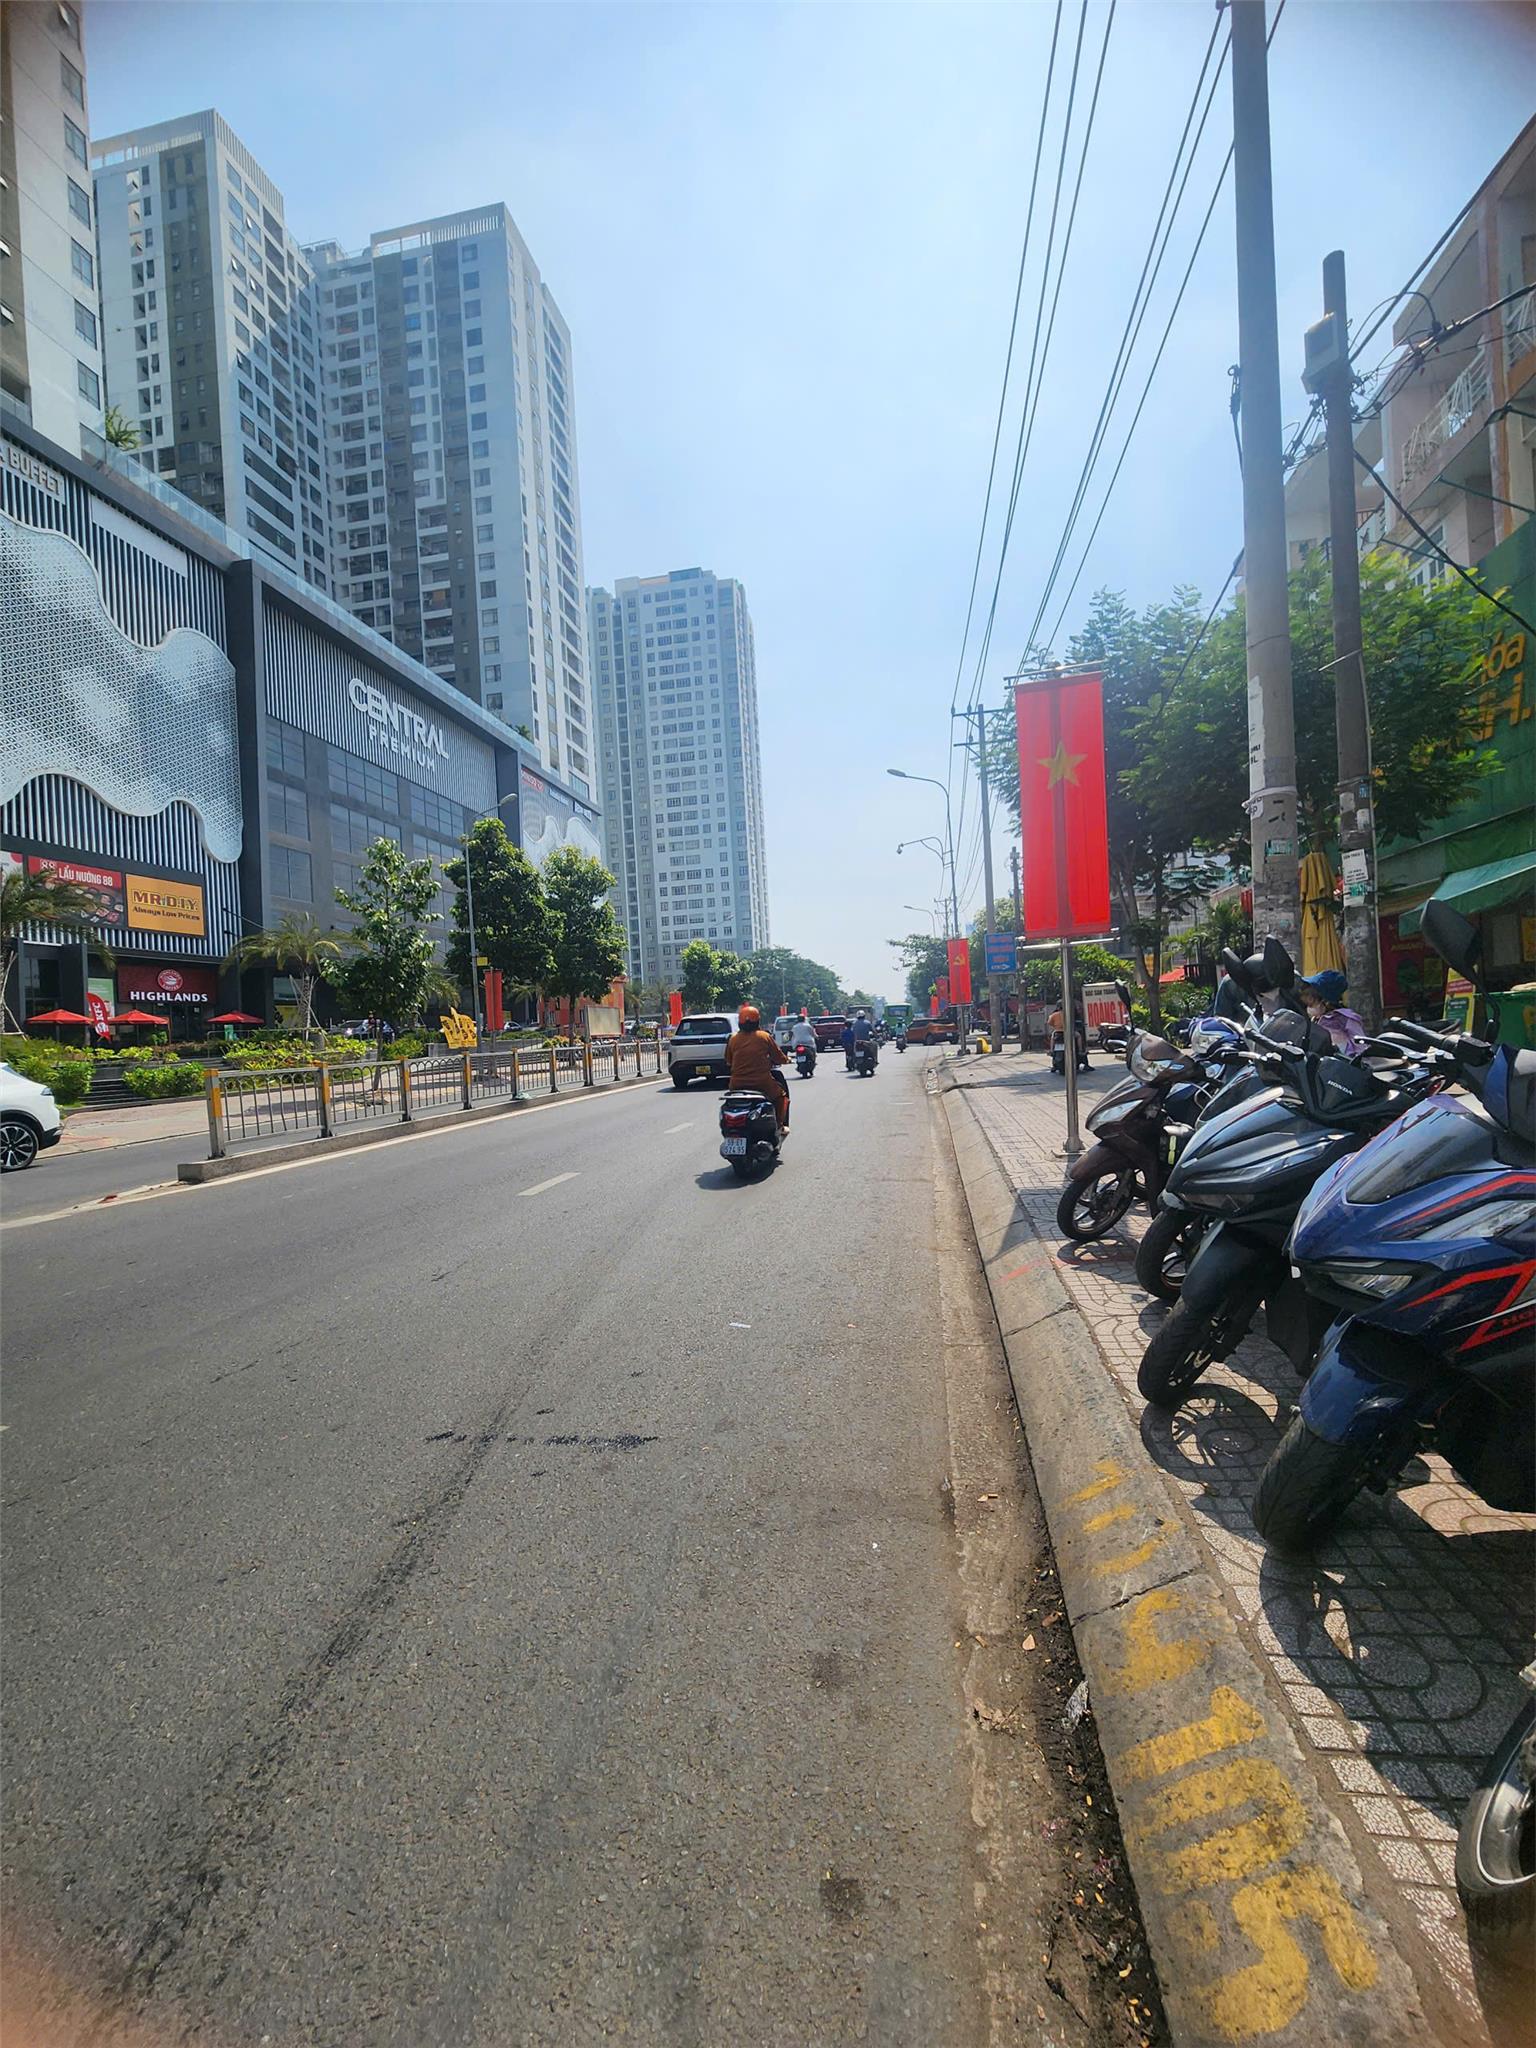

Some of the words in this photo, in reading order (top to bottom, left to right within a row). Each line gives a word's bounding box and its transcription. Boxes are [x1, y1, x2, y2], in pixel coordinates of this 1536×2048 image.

[8, 446, 62, 496] BUFFET
[349, 678, 449, 760] CENTRAL
[368, 723, 435, 773] PREMIUM
[102, 875, 113, 887] 88
[133, 906, 161, 917] Always
[162, 909, 177, 918] Low
[178, 912, 200, 922] Prices
[130, 990, 208, 1003] HIGHLANDS
[93, 1001, 104, 1018] KFC
[1327, 1080, 1353, 1096] HONDA
